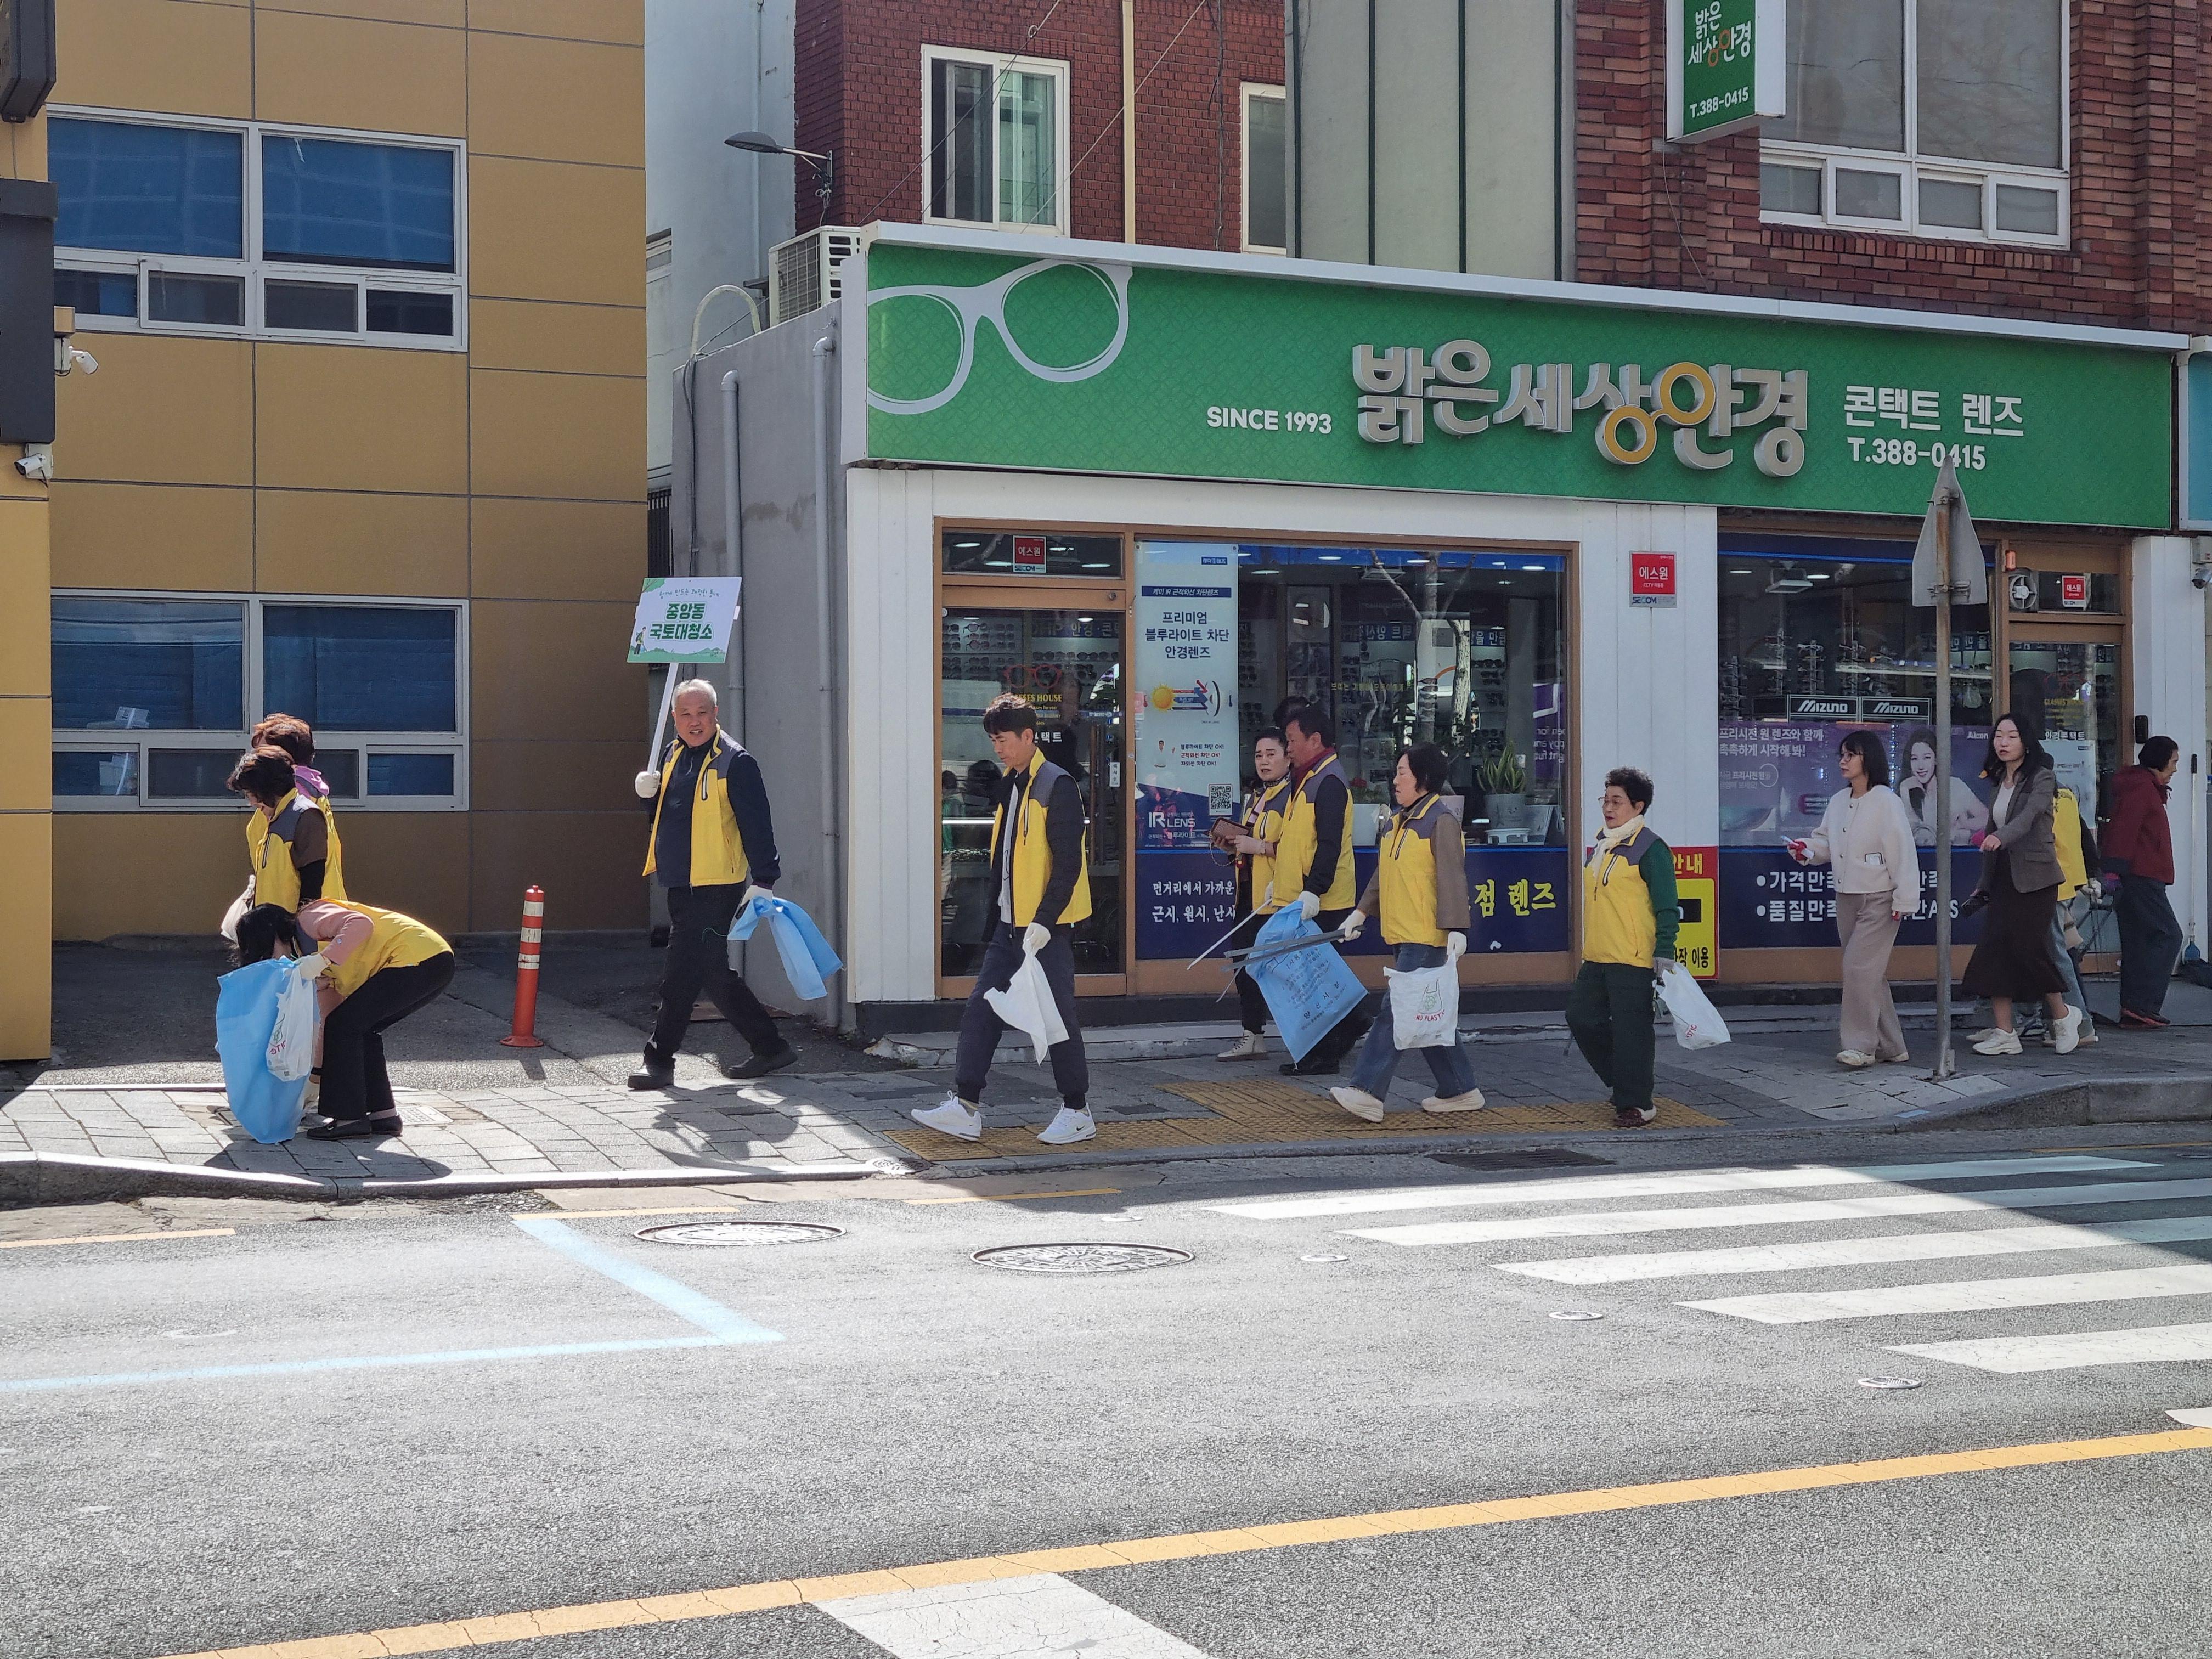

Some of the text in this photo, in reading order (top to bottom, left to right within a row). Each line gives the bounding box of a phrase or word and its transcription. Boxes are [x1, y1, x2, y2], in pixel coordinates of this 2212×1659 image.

[1695, 1, 1722, 40] 밝은
[1688, 20, 1752, 67] 세상안경
[1689, 86, 1749, 119] T.388-0415
[1206, 406, 1332, 433] SINCE 1993
[1843, 385, 2024, 437] 콘택트 렌즈
[1847, 437, 1986, 470] T.388-0415
[1018, 546, 1041, 557] 에스원
[1639, 566, 1668, 580] 에스원
[666, 603, 706, 620] 중앙동
[1162, 611, 1207, 624] 프리미엄
[650, 623, 713, 640] 국토대청소
[1145, 628, 1229, 642] 블루라이트 차단
[1165, 646, 1211, 659] 안경렌즈
[1037, 693, 1063, 702] HOUSE
[1719, 727, 1824, 741] 프리시전 원 렌즈와 함께
[1967, 731, 1989, 740] Alcon
[1719, 743, 1758, 757] 촉촉하게
[1760, 744, 1791, 757] 시작해
[1148, 811, 1195, 828] IR LENS
[1153, 880, 1234, 896] 먼거리에서 가까운
[1468, 878, 1556, 918] 점 렌즈
[1152, 905, 1179, 923] 근시,
[1183, 905, 1209, 923] 원시,
[1692, 947, 1709, 968] 이용
